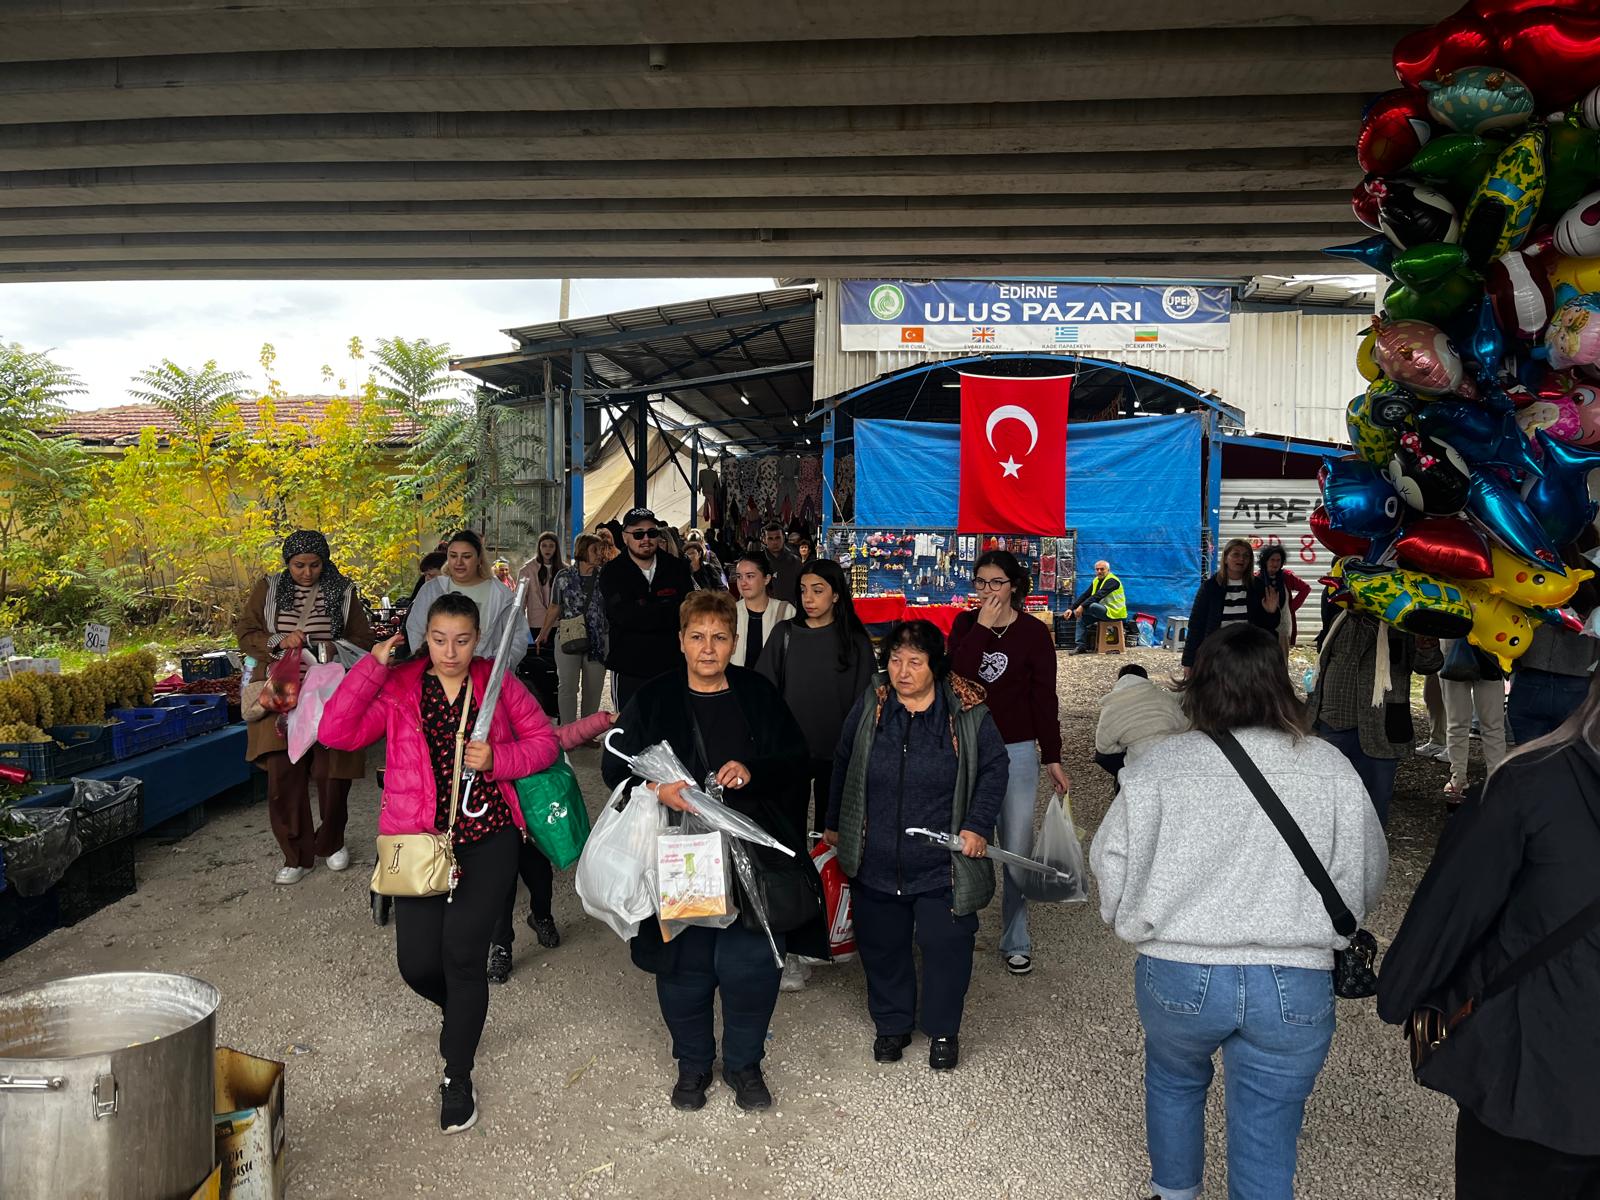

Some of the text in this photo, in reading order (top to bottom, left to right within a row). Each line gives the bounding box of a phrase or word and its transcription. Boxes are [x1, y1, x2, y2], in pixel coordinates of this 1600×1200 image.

[999, 283, 1058, 299] EDİRNE
[924, 301, 1142, 322] ULUS PAZARI
[1232, 497, 1323, 523] ATRE
[1300, 534, 1316, 564] 8
[85, 631, 99, 648] 80
